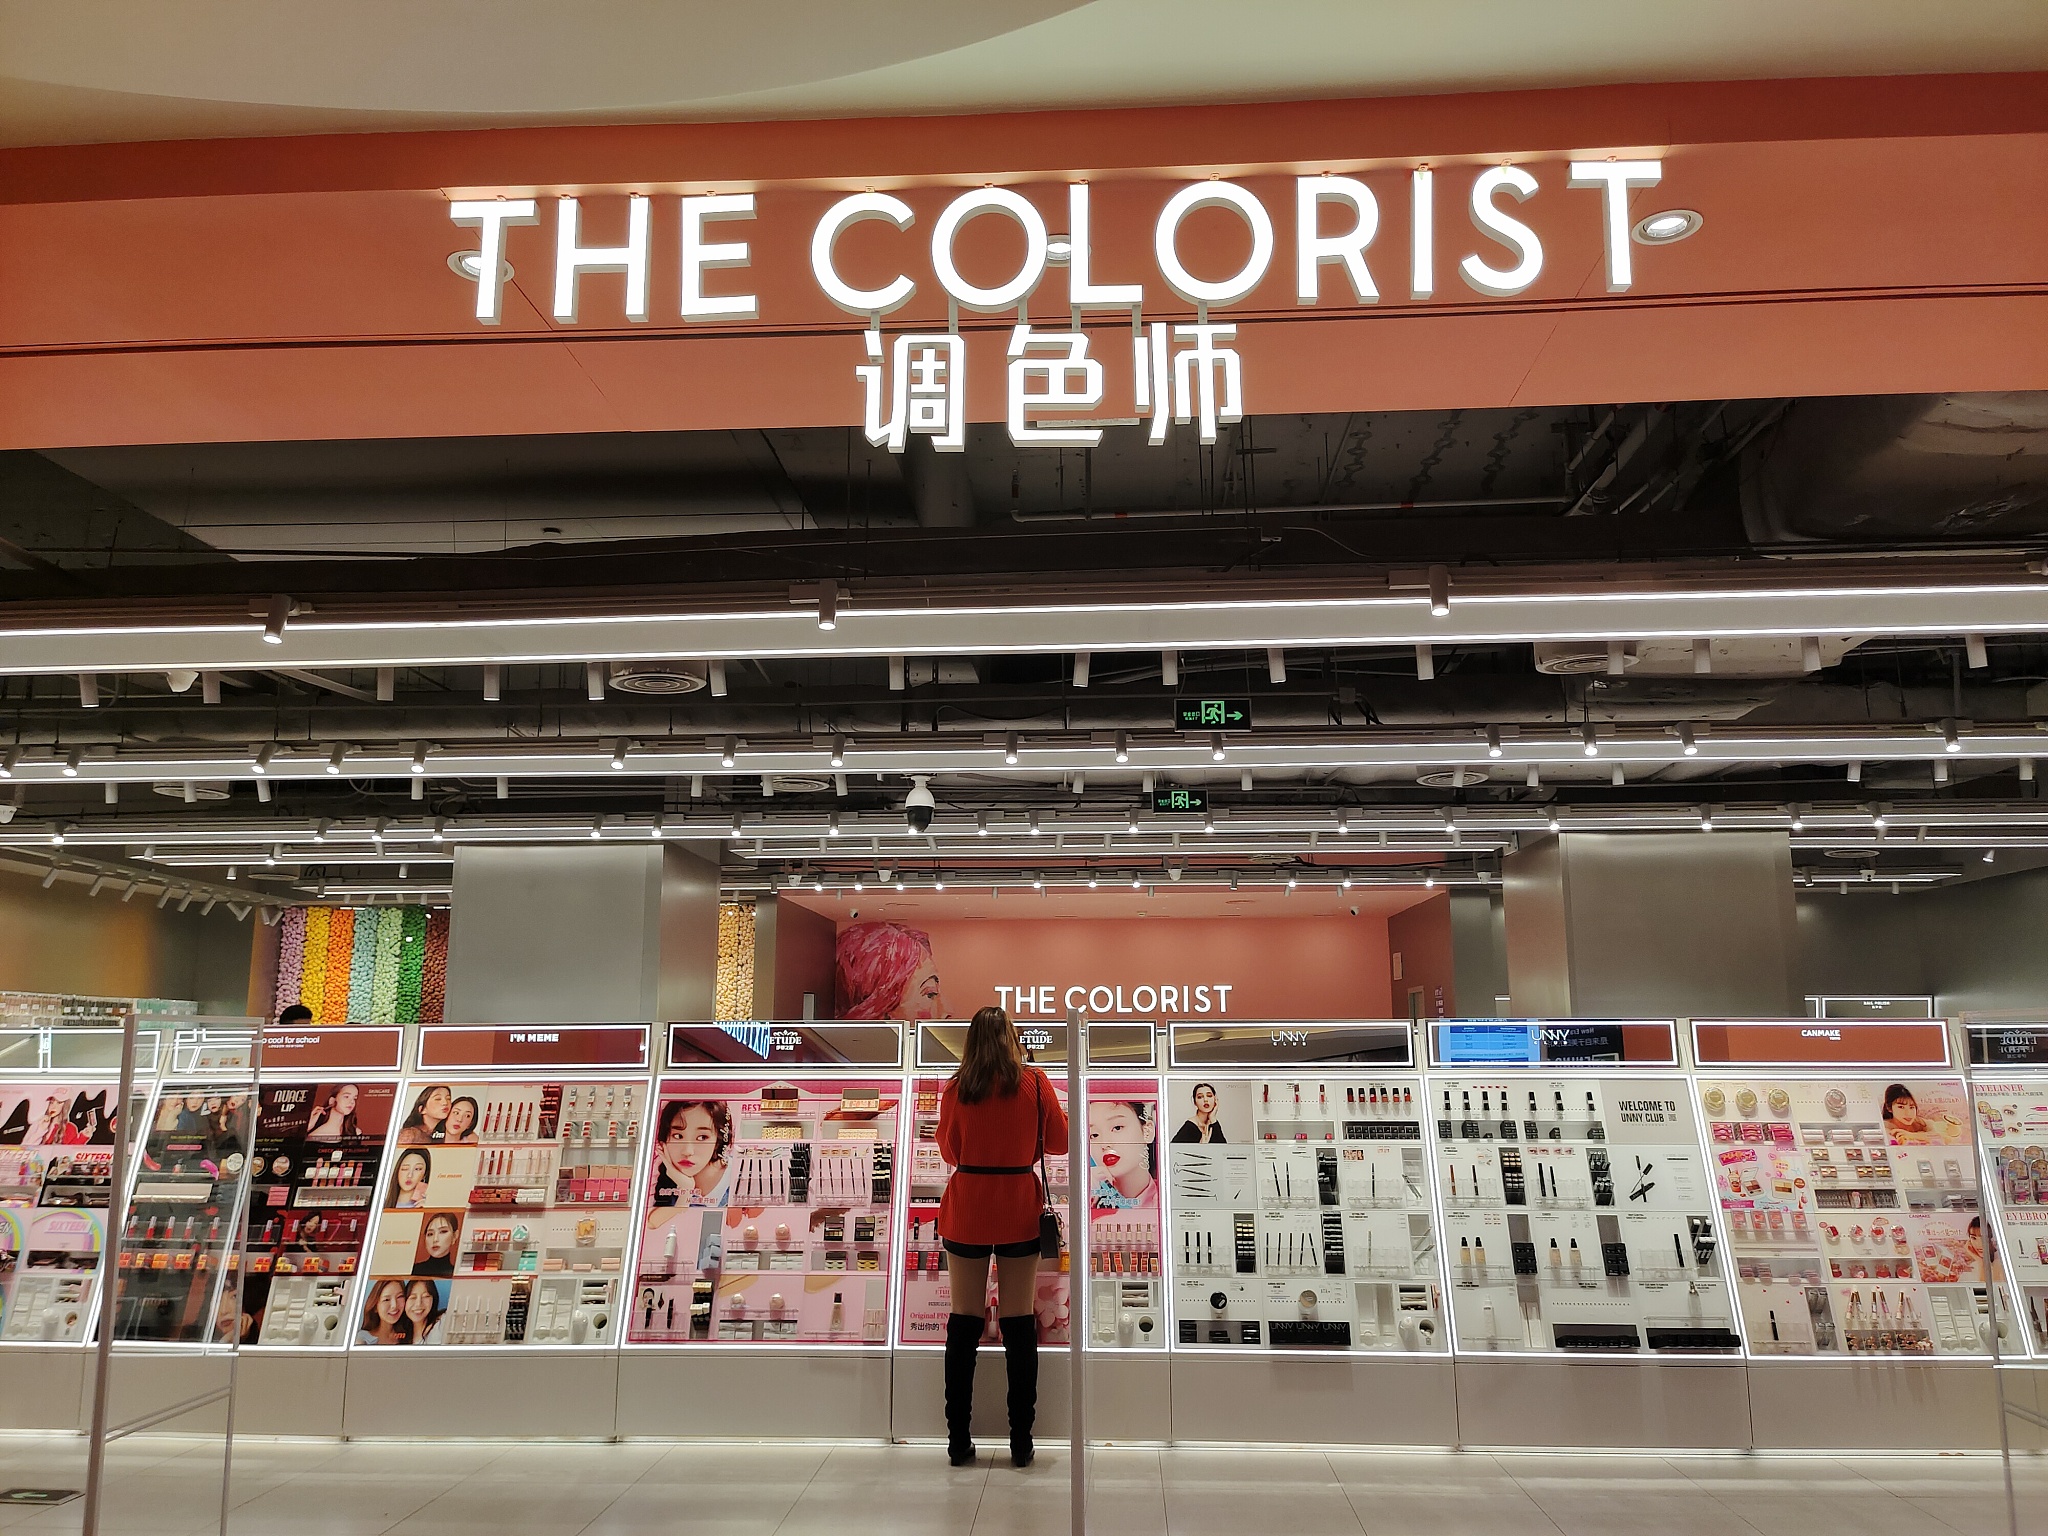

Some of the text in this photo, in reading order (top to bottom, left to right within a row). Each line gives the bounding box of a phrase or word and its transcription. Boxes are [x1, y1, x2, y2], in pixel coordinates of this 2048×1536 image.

[449, 160, 1662, 325] THE COLORIST
[856, 322, 1243, 454] 调色师
[994, 985, 1233, 1014] THE COLORIST
[510, 1033, 560, 1042] I'M MEME
[1271, 1030, 1309, 1042] UNNY
[1531, 1029, 1570, 1041] UNNY
[1801, 1029, 1841, 1037] CANMAKE
[267, 1036, 284, 1044] cool
[284, 1035, 296, 1044] for
[295, 1035, 321, 1044] school
[769, 1036, 802, 1044] ETUDE
[1019, 1035, 1053, 1044] ETUDE
[1973, 1084, 2025, 1092] EYELINER
[273, 1089, 309, 1103] NUAGE
[280, 1103, 295, 1113] LIP
[1618, 1100, 1676, 1112] WELCOME TO
[1620, 1113, 1665, 1123] UNNY CLUB
[75, 1152, 114, 1163] SIXTEEN
[49, 1220, 91, 1232] SIXTEEN
[910, 1312, 950, 1320] Original PIN
